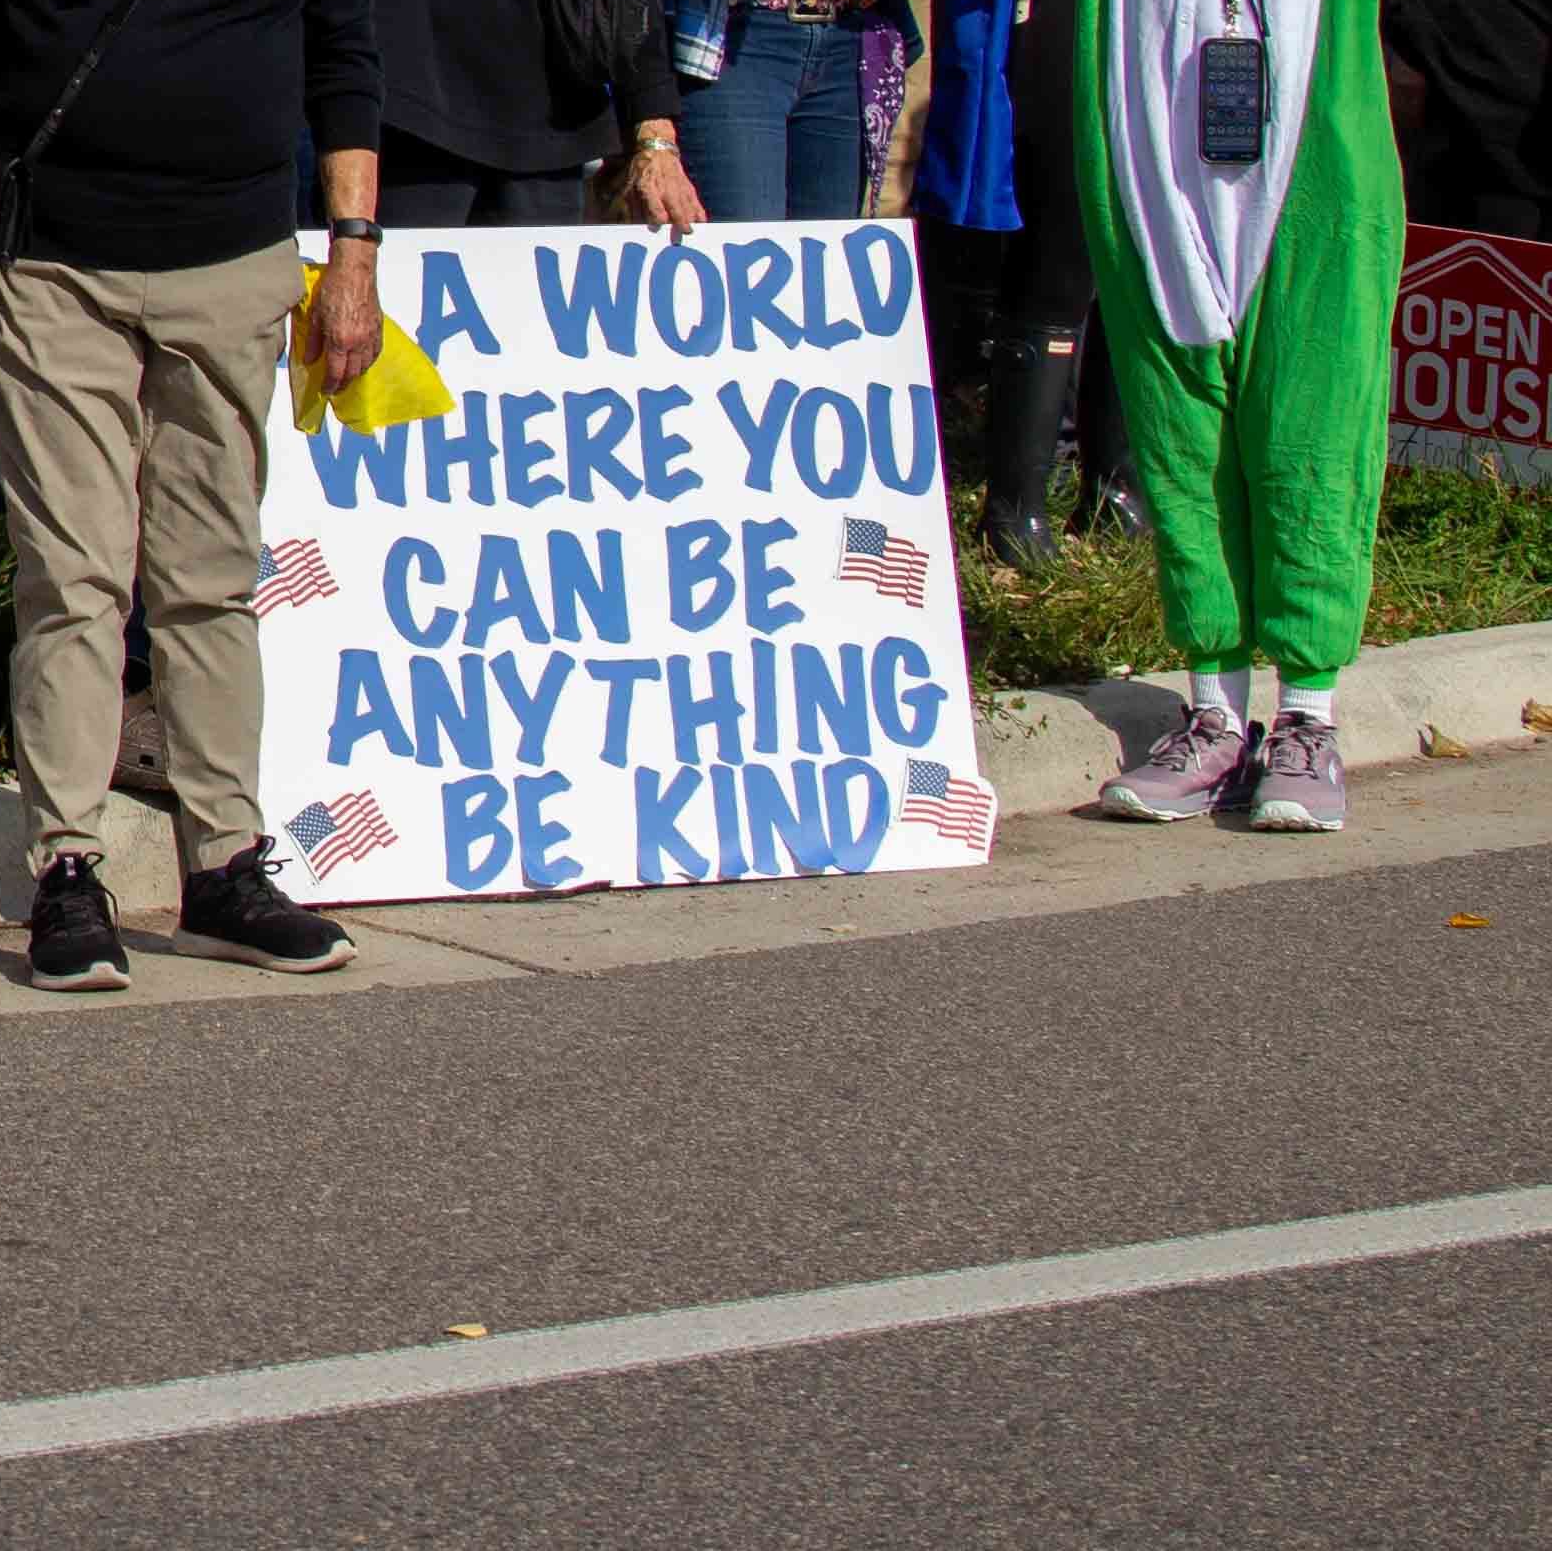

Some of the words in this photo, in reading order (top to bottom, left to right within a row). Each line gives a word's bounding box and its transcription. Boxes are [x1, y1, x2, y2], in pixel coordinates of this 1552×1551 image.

[415, 251, 500, 364] A
[535, 224, 913, 358] WORLD
[1402, 294, 1539, 364] OPEN
[308, 385, 703, 508] WHERE
[717, 379, 937, 499] YOU
[383, 528, 631, 648] CAN
[665, 517, 805, 635] BE
[327, 636, 948, 769] ANYTHING
[441, 770, 583, 891] BE
[634, 757, 893, 883] KIND
